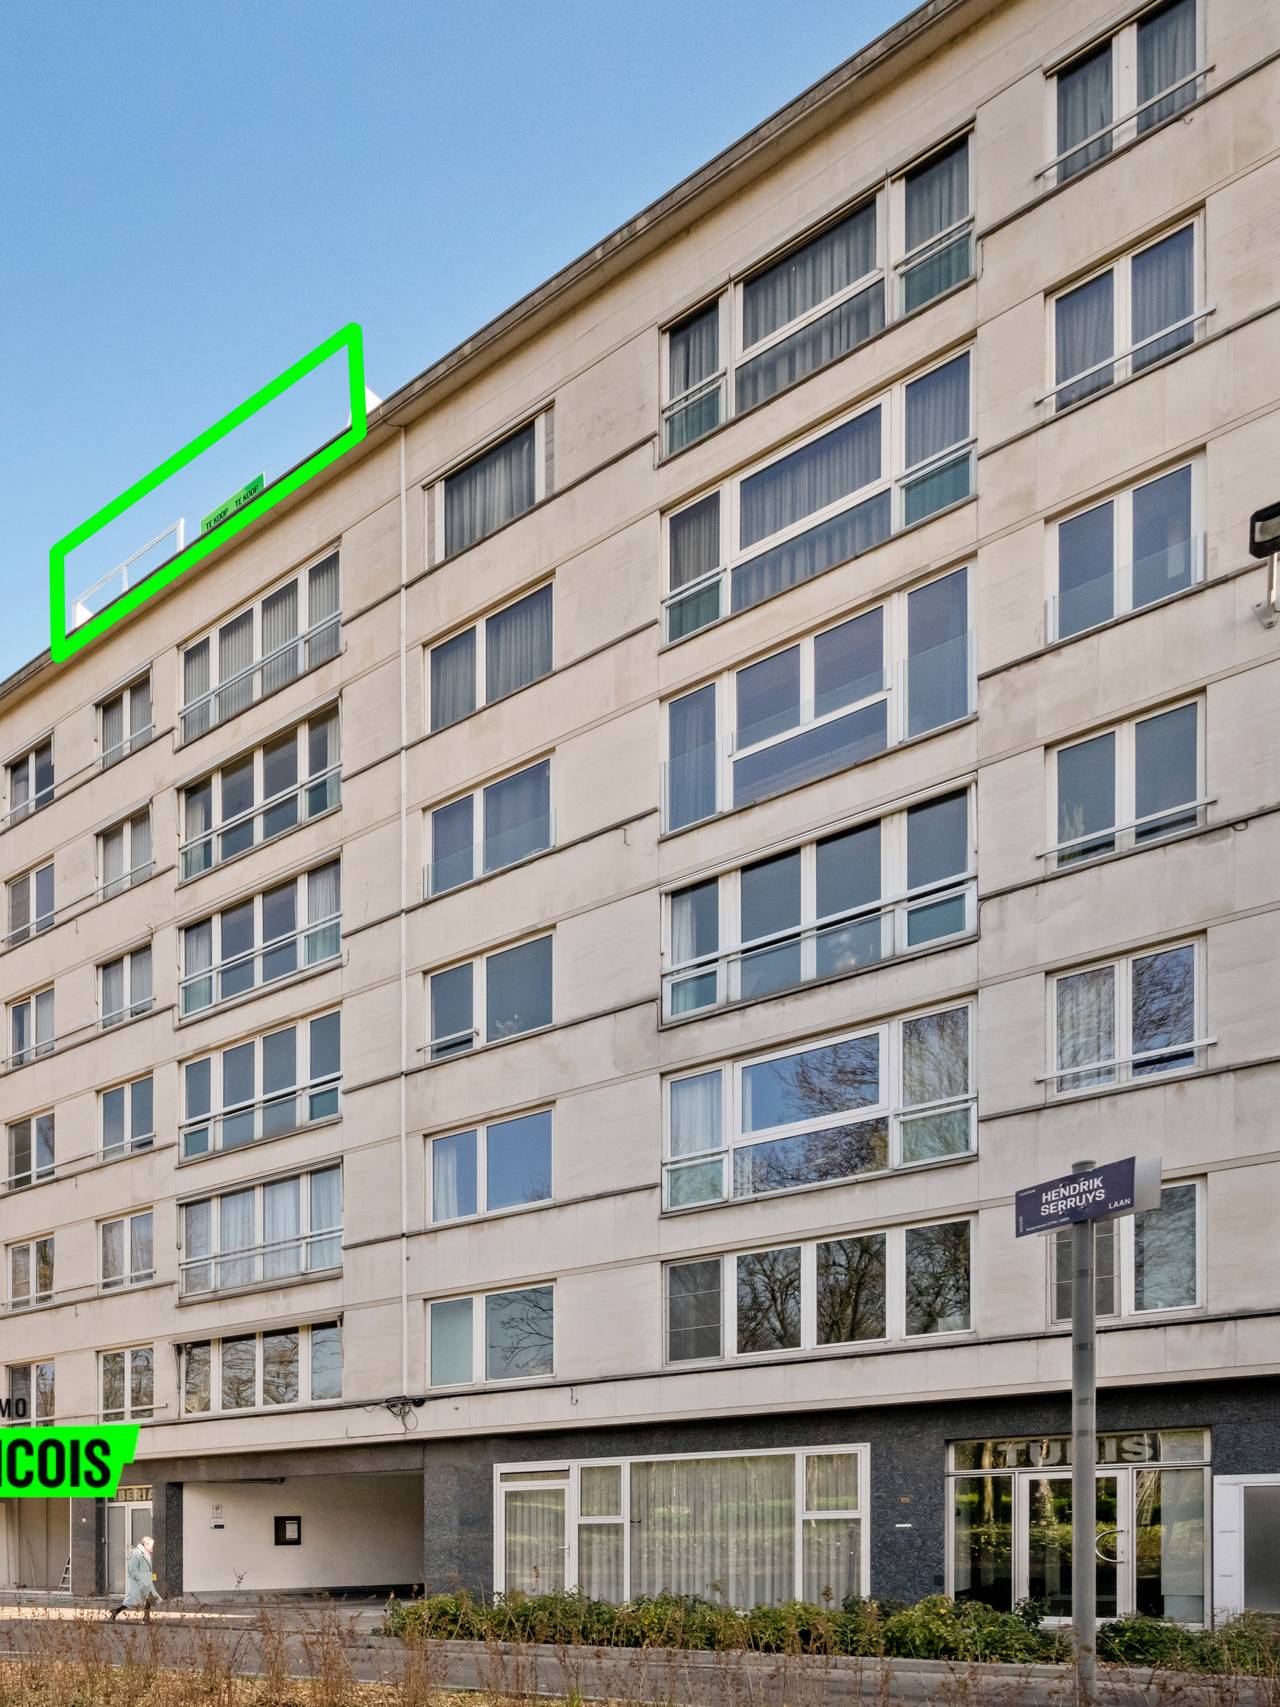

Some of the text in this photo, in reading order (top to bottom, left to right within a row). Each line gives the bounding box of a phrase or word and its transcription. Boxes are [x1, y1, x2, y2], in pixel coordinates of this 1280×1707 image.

[243, 484, 259, 502] KOOP
[213, 507, 229, 524] KOOP
[1041, 1176, 1104, 1203] HENDRIK
[1040, 1189, 1106, 1216] SERRUYS
[1108, 1198, 1132, 1210] LAAN
